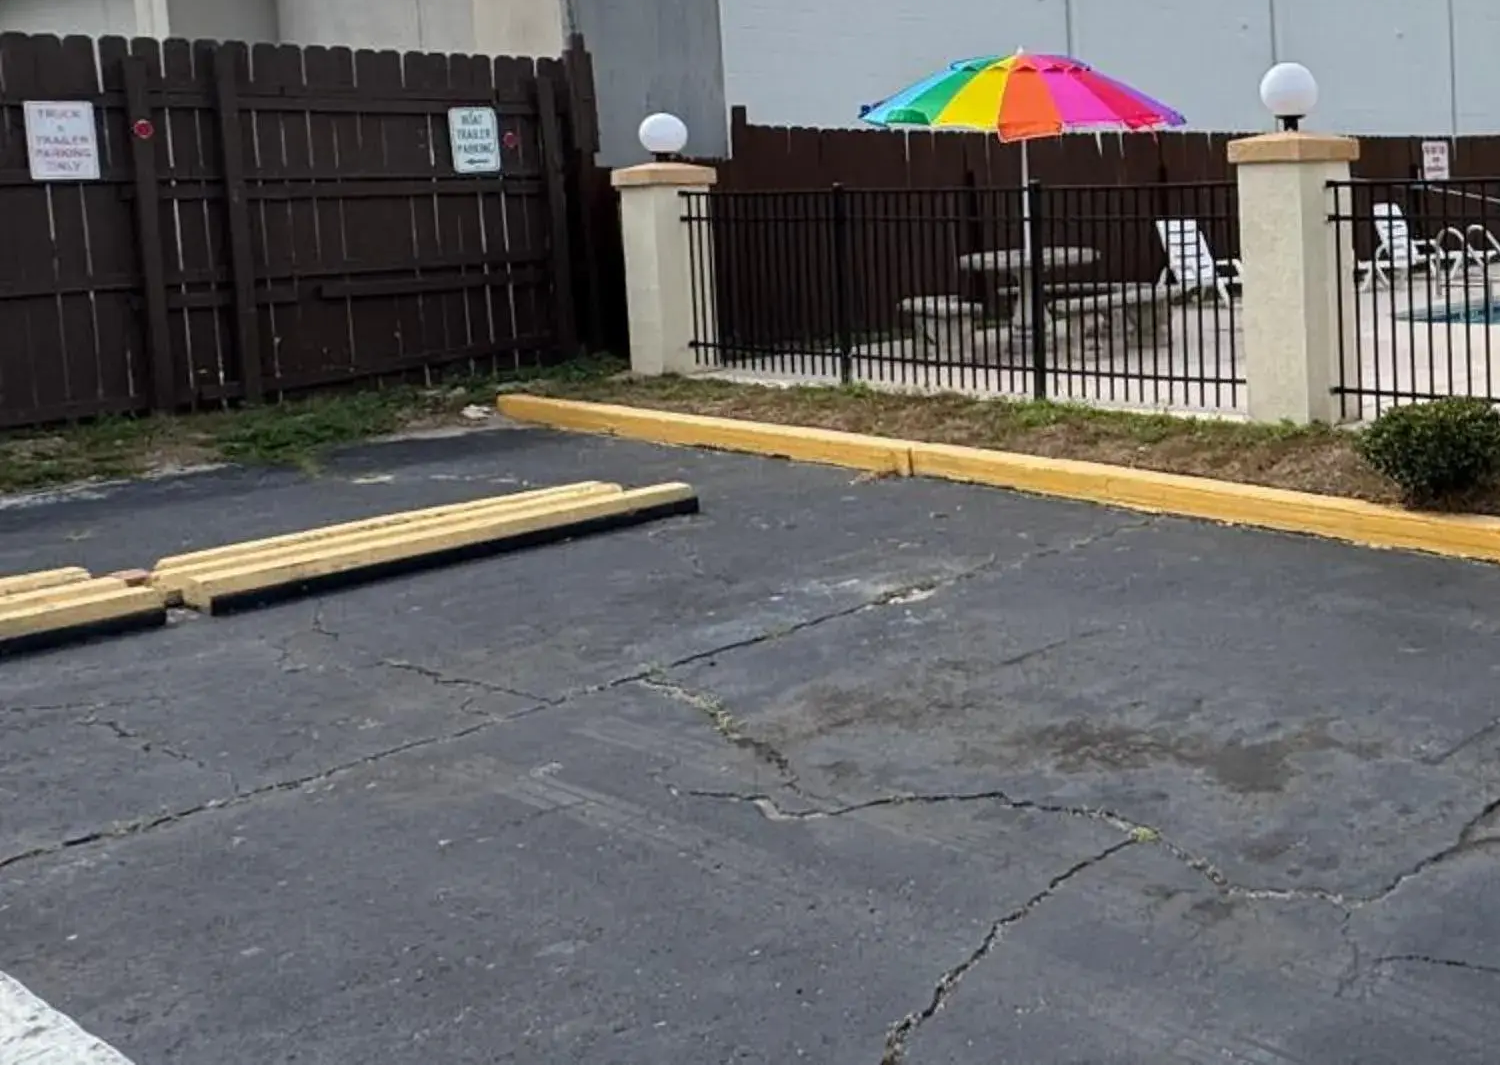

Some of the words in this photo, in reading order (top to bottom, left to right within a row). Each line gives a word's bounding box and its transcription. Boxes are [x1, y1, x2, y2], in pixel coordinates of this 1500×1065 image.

[460, 114, 483, 125] BOAT
[457, 128, 491, 139] TRAILER
[35, 135, 90, 145] TRAILER
[36, 148, 92, 158] PARKING
[457, 142, 494, 154] PARKING
